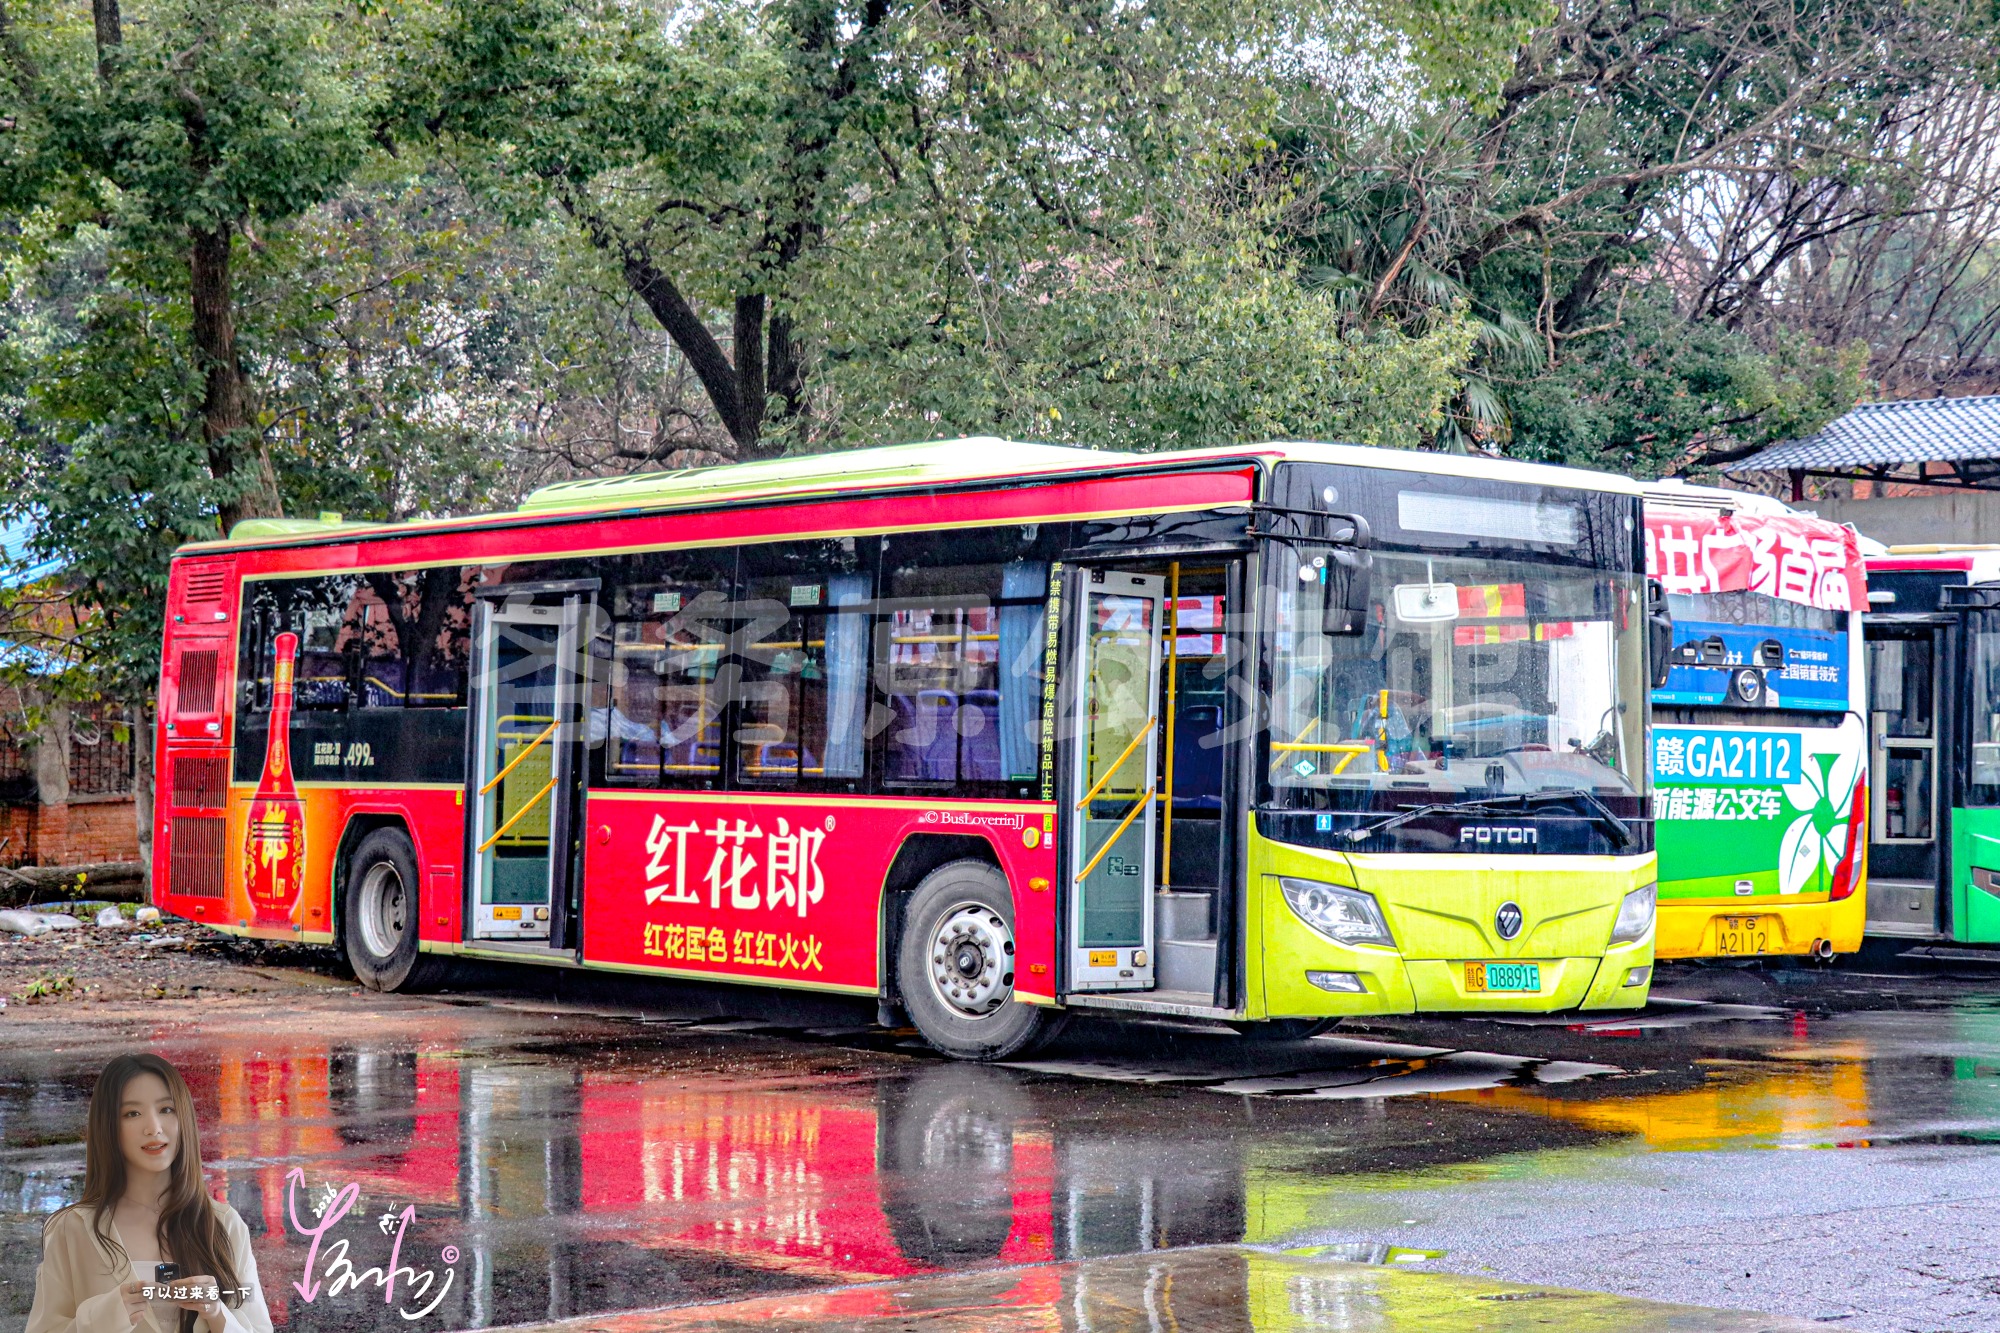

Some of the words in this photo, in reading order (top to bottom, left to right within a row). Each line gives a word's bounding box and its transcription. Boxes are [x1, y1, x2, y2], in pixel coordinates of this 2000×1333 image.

[1041, 562, 1062, 801] 严禁携带易燃易爆危险物品上车
[1656, 735, 1791, 779] 赣GA2112
[1653, 787, 1782, 821] 新能源公交车
[1460, 826, 1537, 844] FOTON
[643, 921, 728, 963] 红花国色
[733, 928, 823, 972] 红红火火
[1720, 932, 1766, 955] A2112
